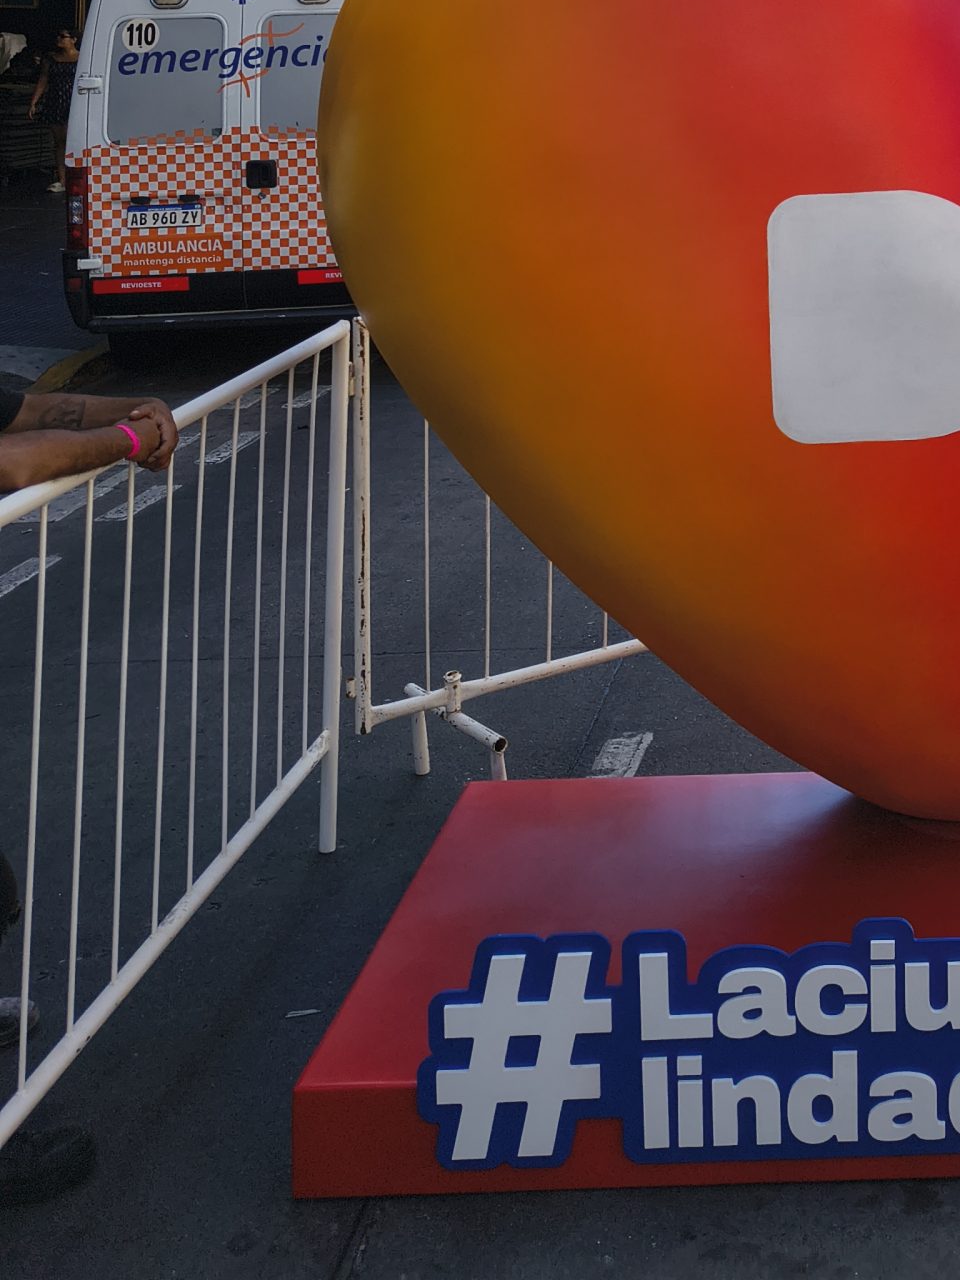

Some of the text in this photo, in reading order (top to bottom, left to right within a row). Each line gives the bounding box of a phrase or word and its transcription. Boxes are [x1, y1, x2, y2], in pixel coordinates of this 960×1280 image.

[126, 23, 156, 47] 110
[131, 211, 198, 226] AB 960 ZY
[122, 239, 223, 255] AMBULANCIA
[123, 255, 222, 267] mantenga distancia
